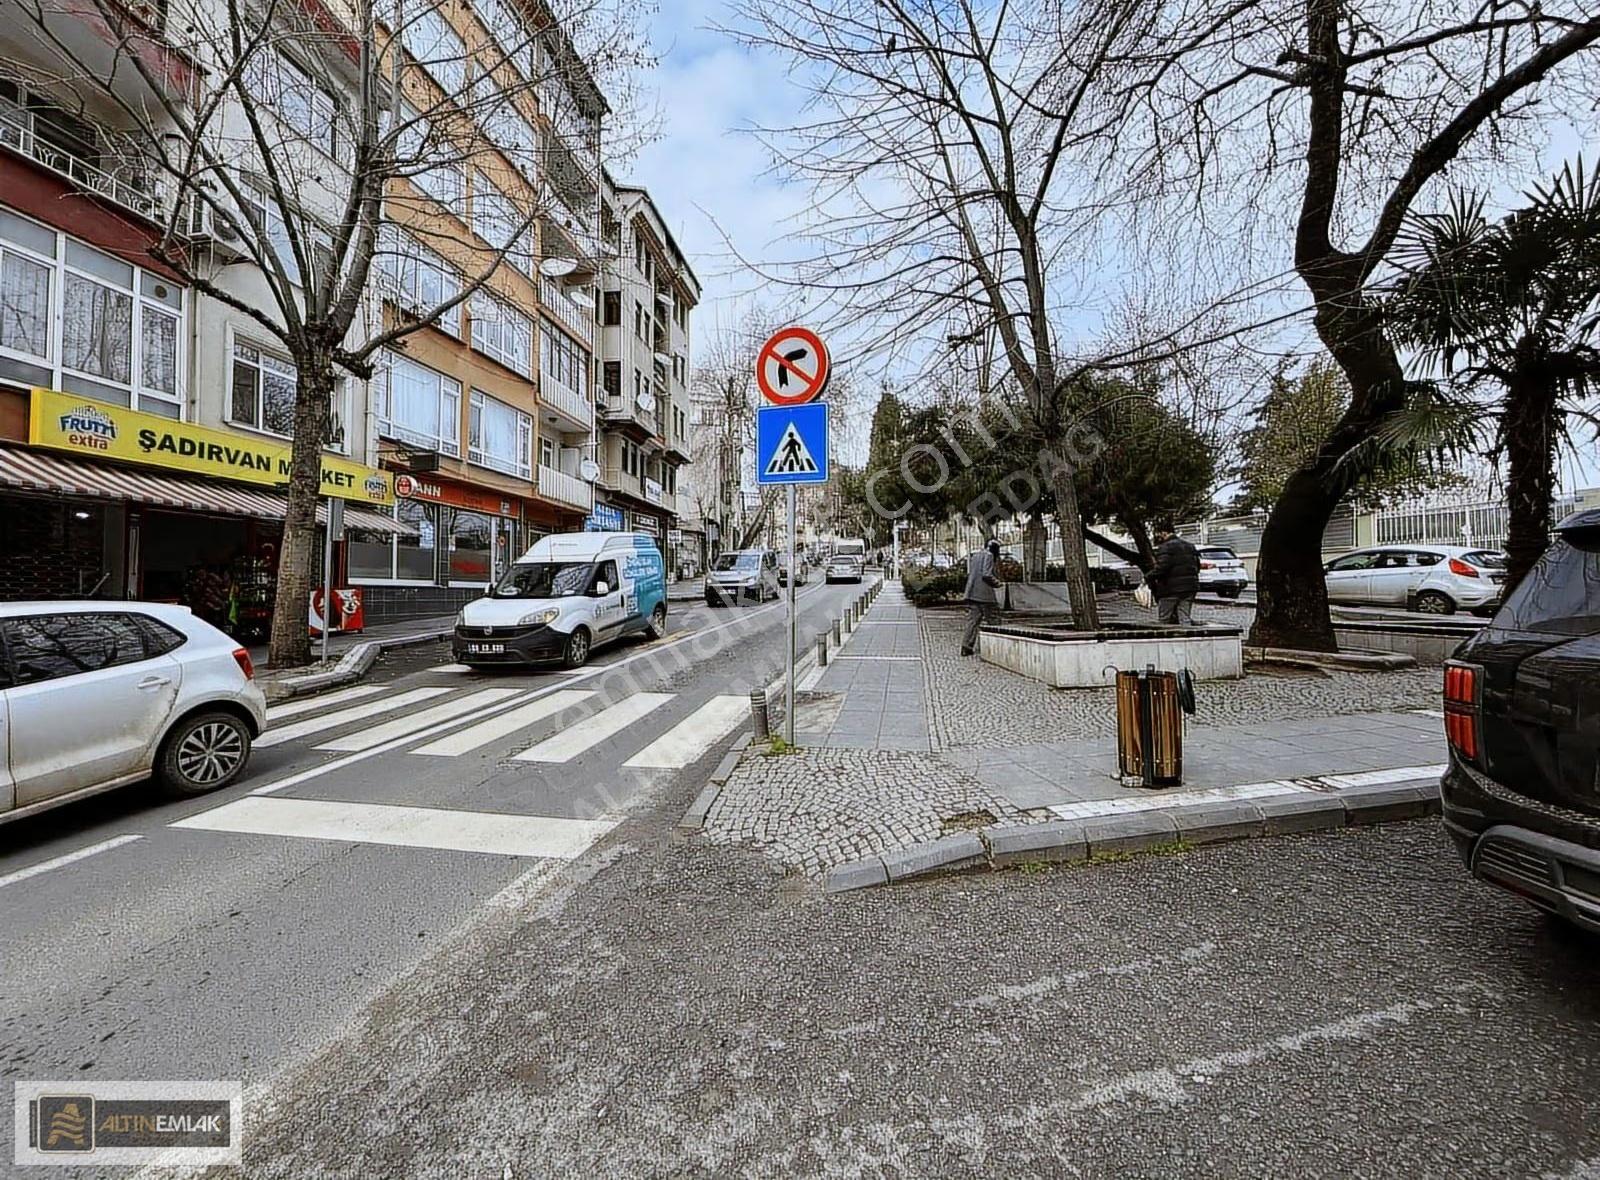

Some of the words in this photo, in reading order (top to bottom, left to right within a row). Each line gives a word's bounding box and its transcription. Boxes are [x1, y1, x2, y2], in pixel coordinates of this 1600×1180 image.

[69, 433, 108, 450] extra
[138, 429, 271, 472] ŞADIRVAN
[278, 459, 355, 488] MKET
